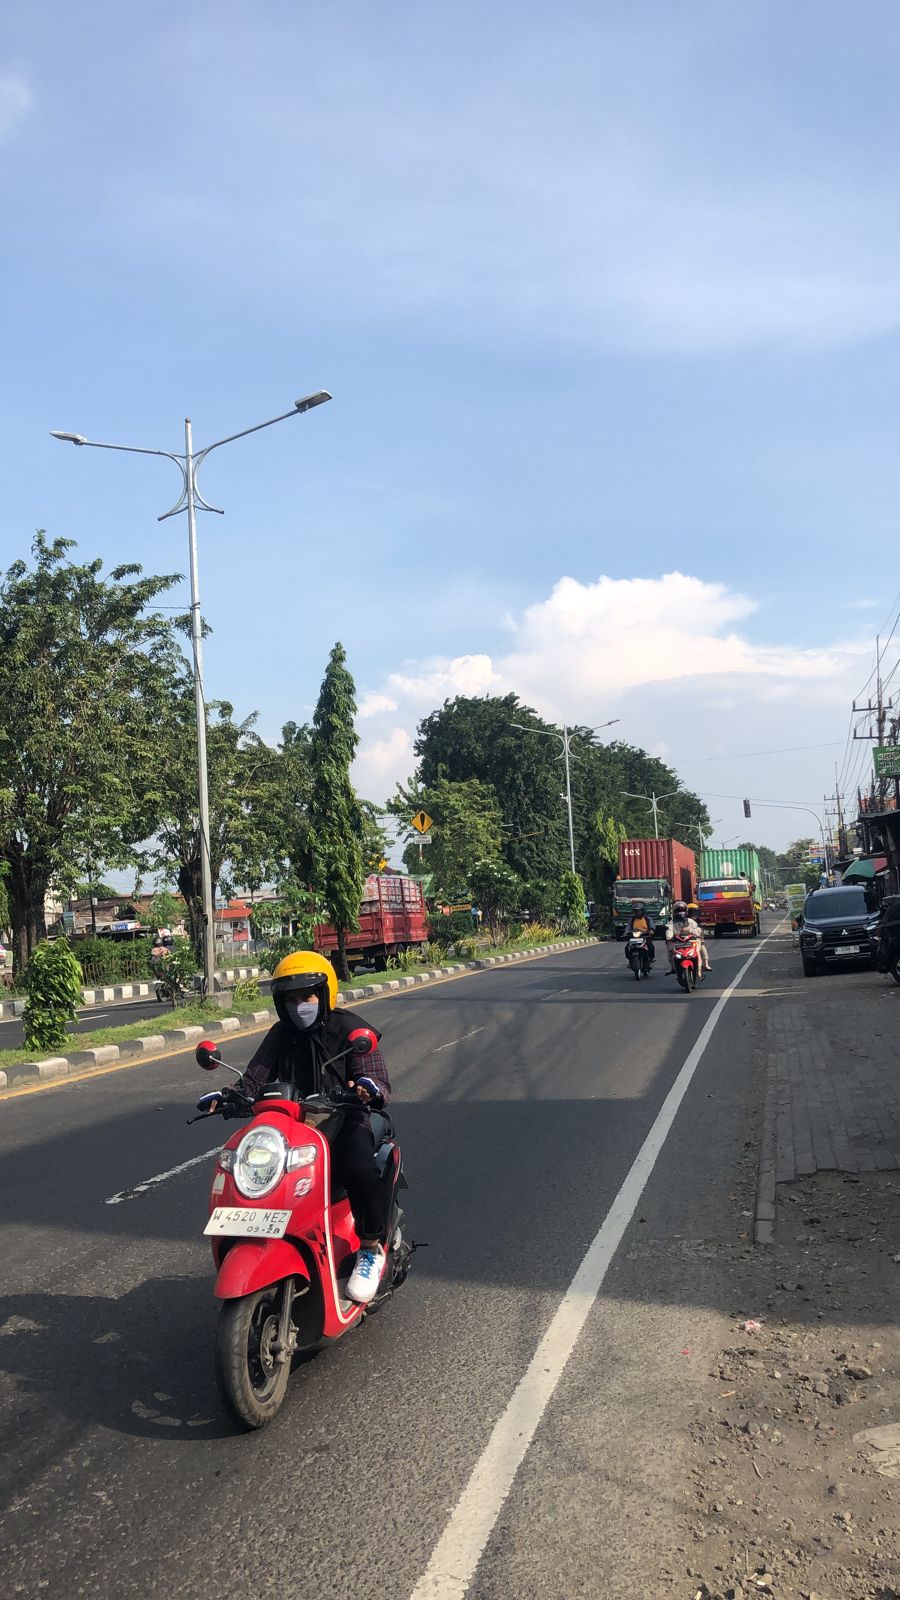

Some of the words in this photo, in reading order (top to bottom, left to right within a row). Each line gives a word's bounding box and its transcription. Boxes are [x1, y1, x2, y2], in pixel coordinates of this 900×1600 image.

[624, 847, 640, 856] tex
[213, 1210, 223, 1220] W
[225, 1211, 257, 1222] 4520
[263, 1212, 287, 1223] NEZ
